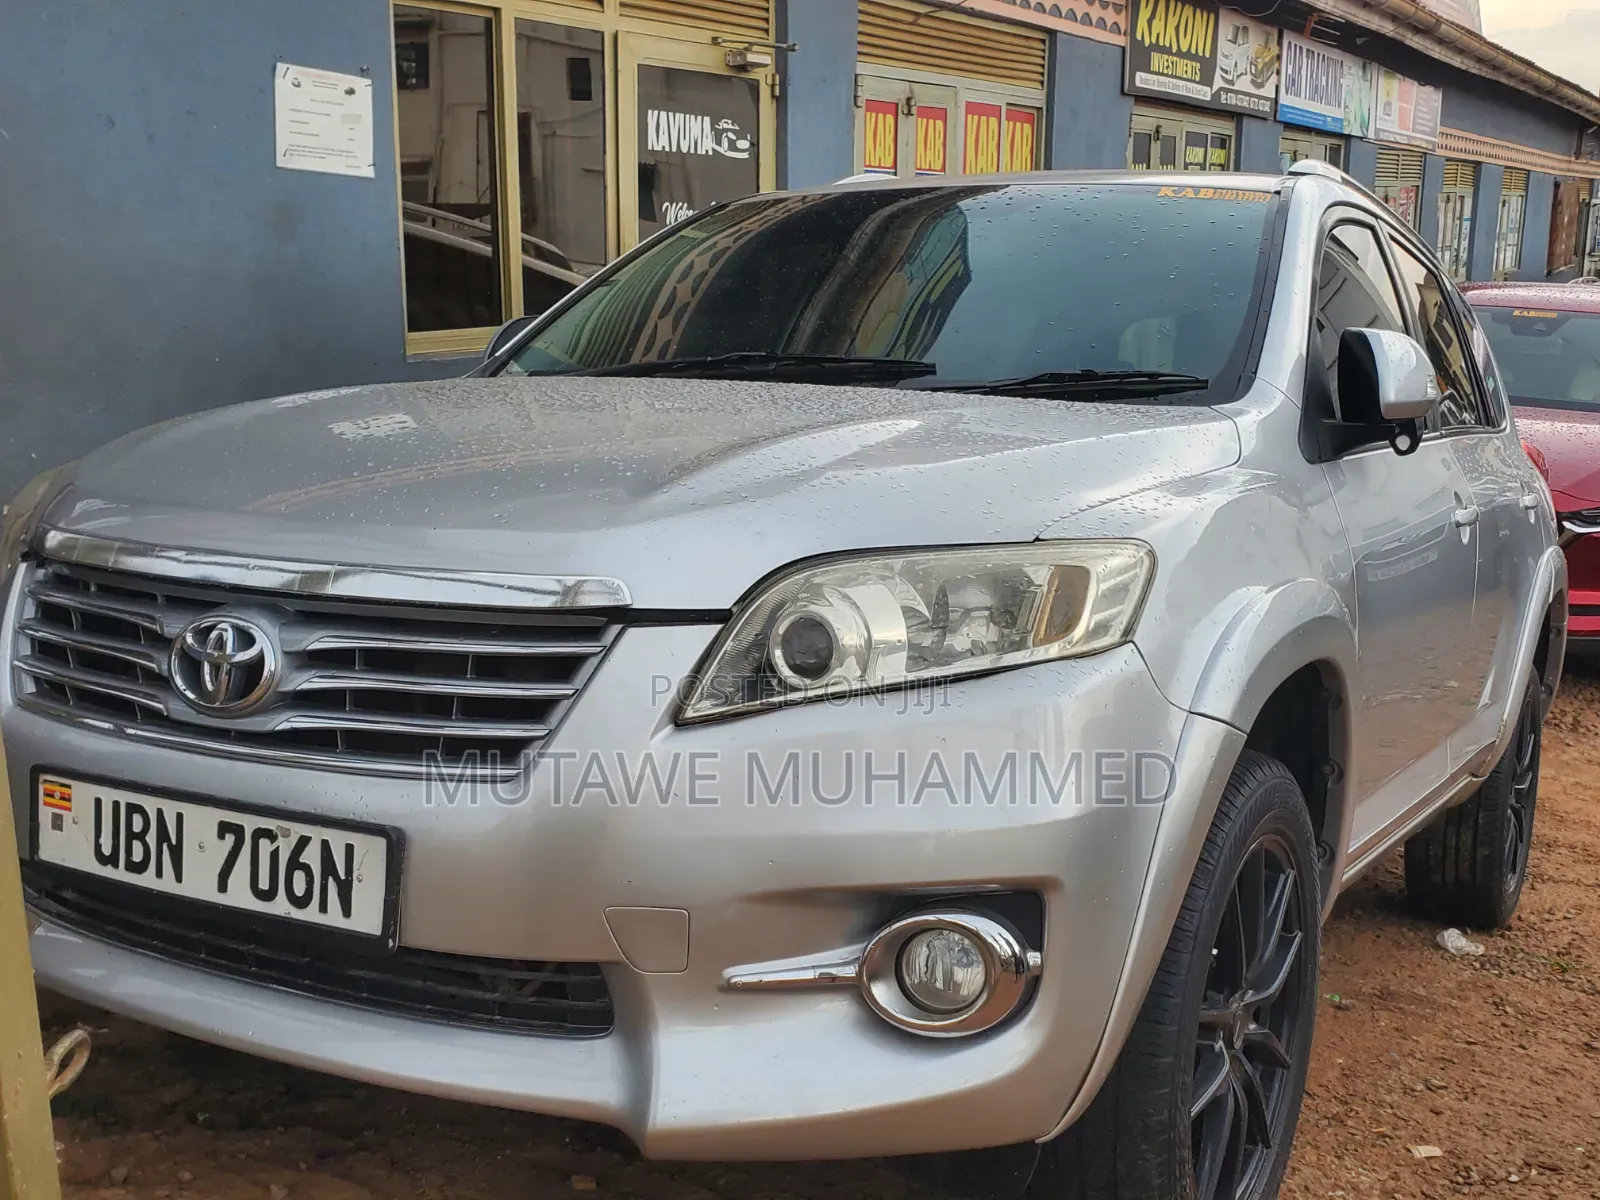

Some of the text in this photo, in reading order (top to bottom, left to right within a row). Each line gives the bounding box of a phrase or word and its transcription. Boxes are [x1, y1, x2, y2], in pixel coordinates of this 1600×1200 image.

[1136, 0, 1215, 58] KAKONI
[1151, 52, 1201, 82] INVESTMENTS
[1285, 40, 1344, 109] CAR TRACKING
[647, 109, 713, 155] KAVUMA
[865, 111, 895, 168] KAB
[917, 117, 944, 171] KAB
[965, 114, 999, 175] KAB
[1003, 120, 1032, 173] KAB
[661, 201, 699, 225] Welco
[93, 796, 355, 920] UBN 706N
